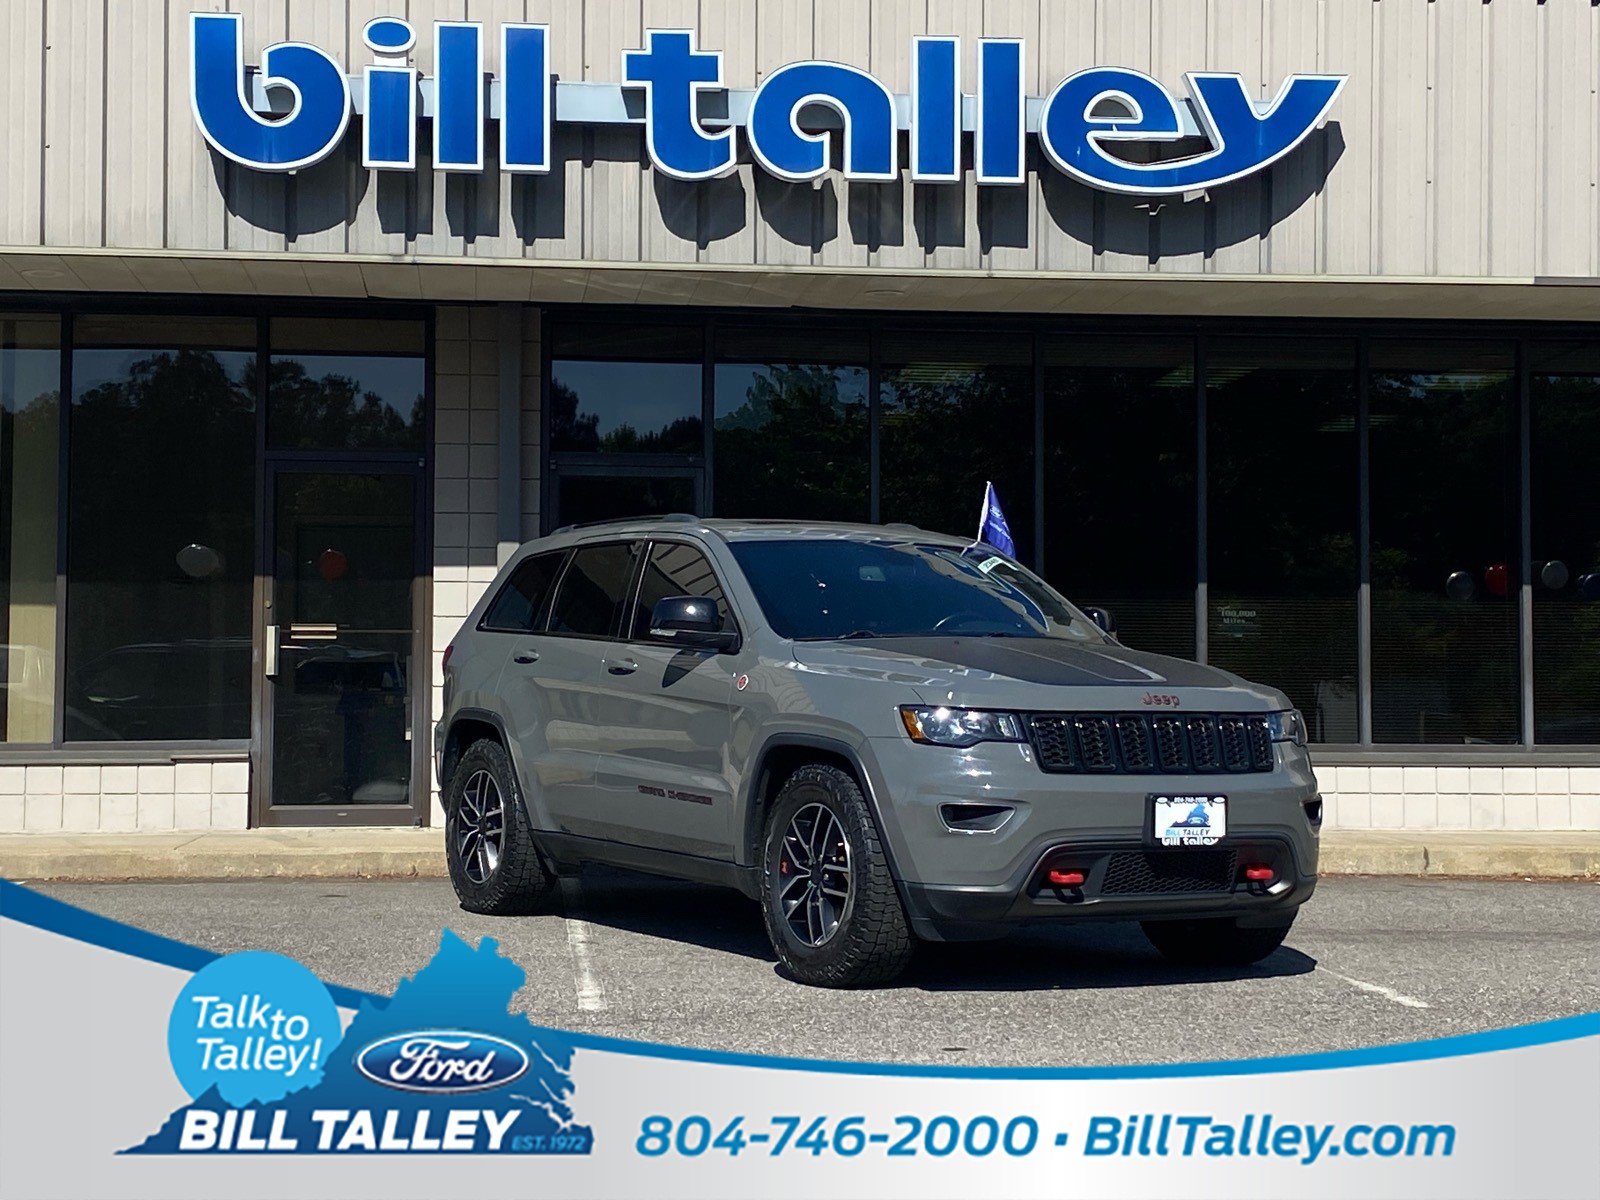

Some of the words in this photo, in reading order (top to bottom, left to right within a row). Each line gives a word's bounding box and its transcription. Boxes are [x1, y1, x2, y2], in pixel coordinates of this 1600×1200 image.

[190, 12, 551, 172] bill
[622, 28, 1348, 196] talley
[1142, 691, 1181, 708] Jeep
